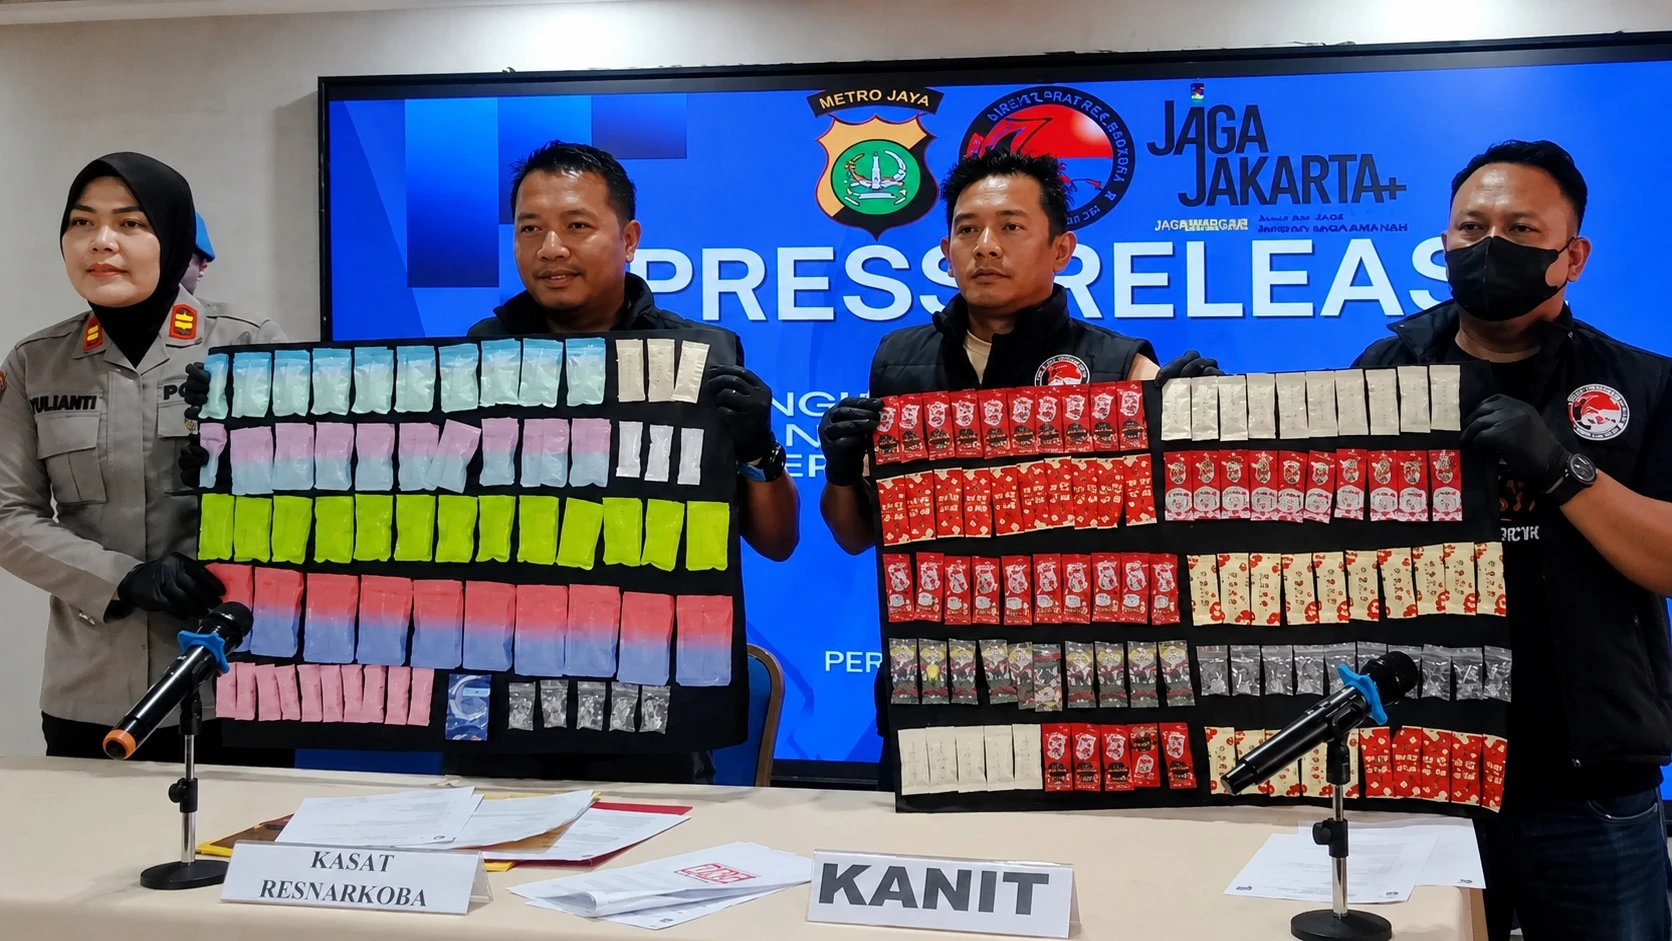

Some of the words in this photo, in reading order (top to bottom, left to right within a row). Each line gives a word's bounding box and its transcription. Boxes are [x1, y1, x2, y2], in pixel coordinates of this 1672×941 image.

[819, 88, 882, 109] METRO
[886, 89, 930, 108] JAYA
[1147, 100, 1269, 155] JAGA
[29, 394, 98, 414] YULIANTI
[310, 851, 394, 872] KASAT
[259, 879, 427, 907] RESNARKOBA
[818, 862, 1050, 915] KANIT
